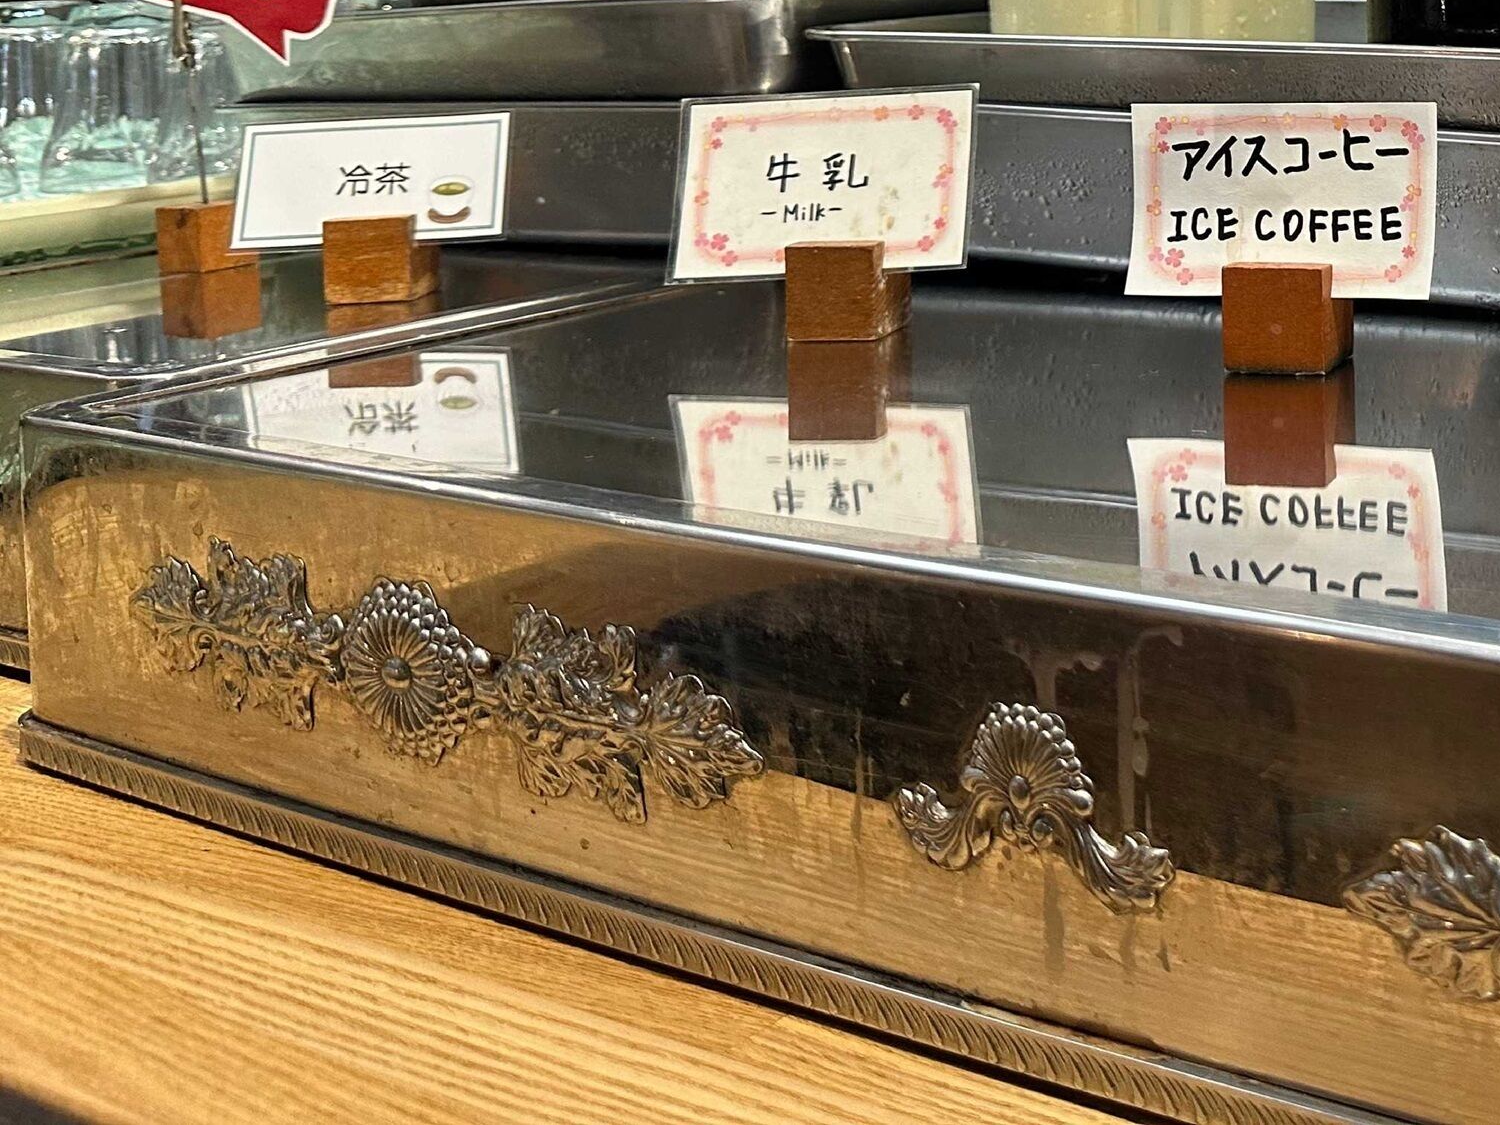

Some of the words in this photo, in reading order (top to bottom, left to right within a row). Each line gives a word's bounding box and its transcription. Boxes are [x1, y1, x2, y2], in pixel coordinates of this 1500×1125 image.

[1171, 129, 1410, 181] アイスコーヒー
[335, 161, 412, 198] 冷茶
[1167, 208, 1239, 244] ICE
[1255, 205, 1403, 243] COFFEE
